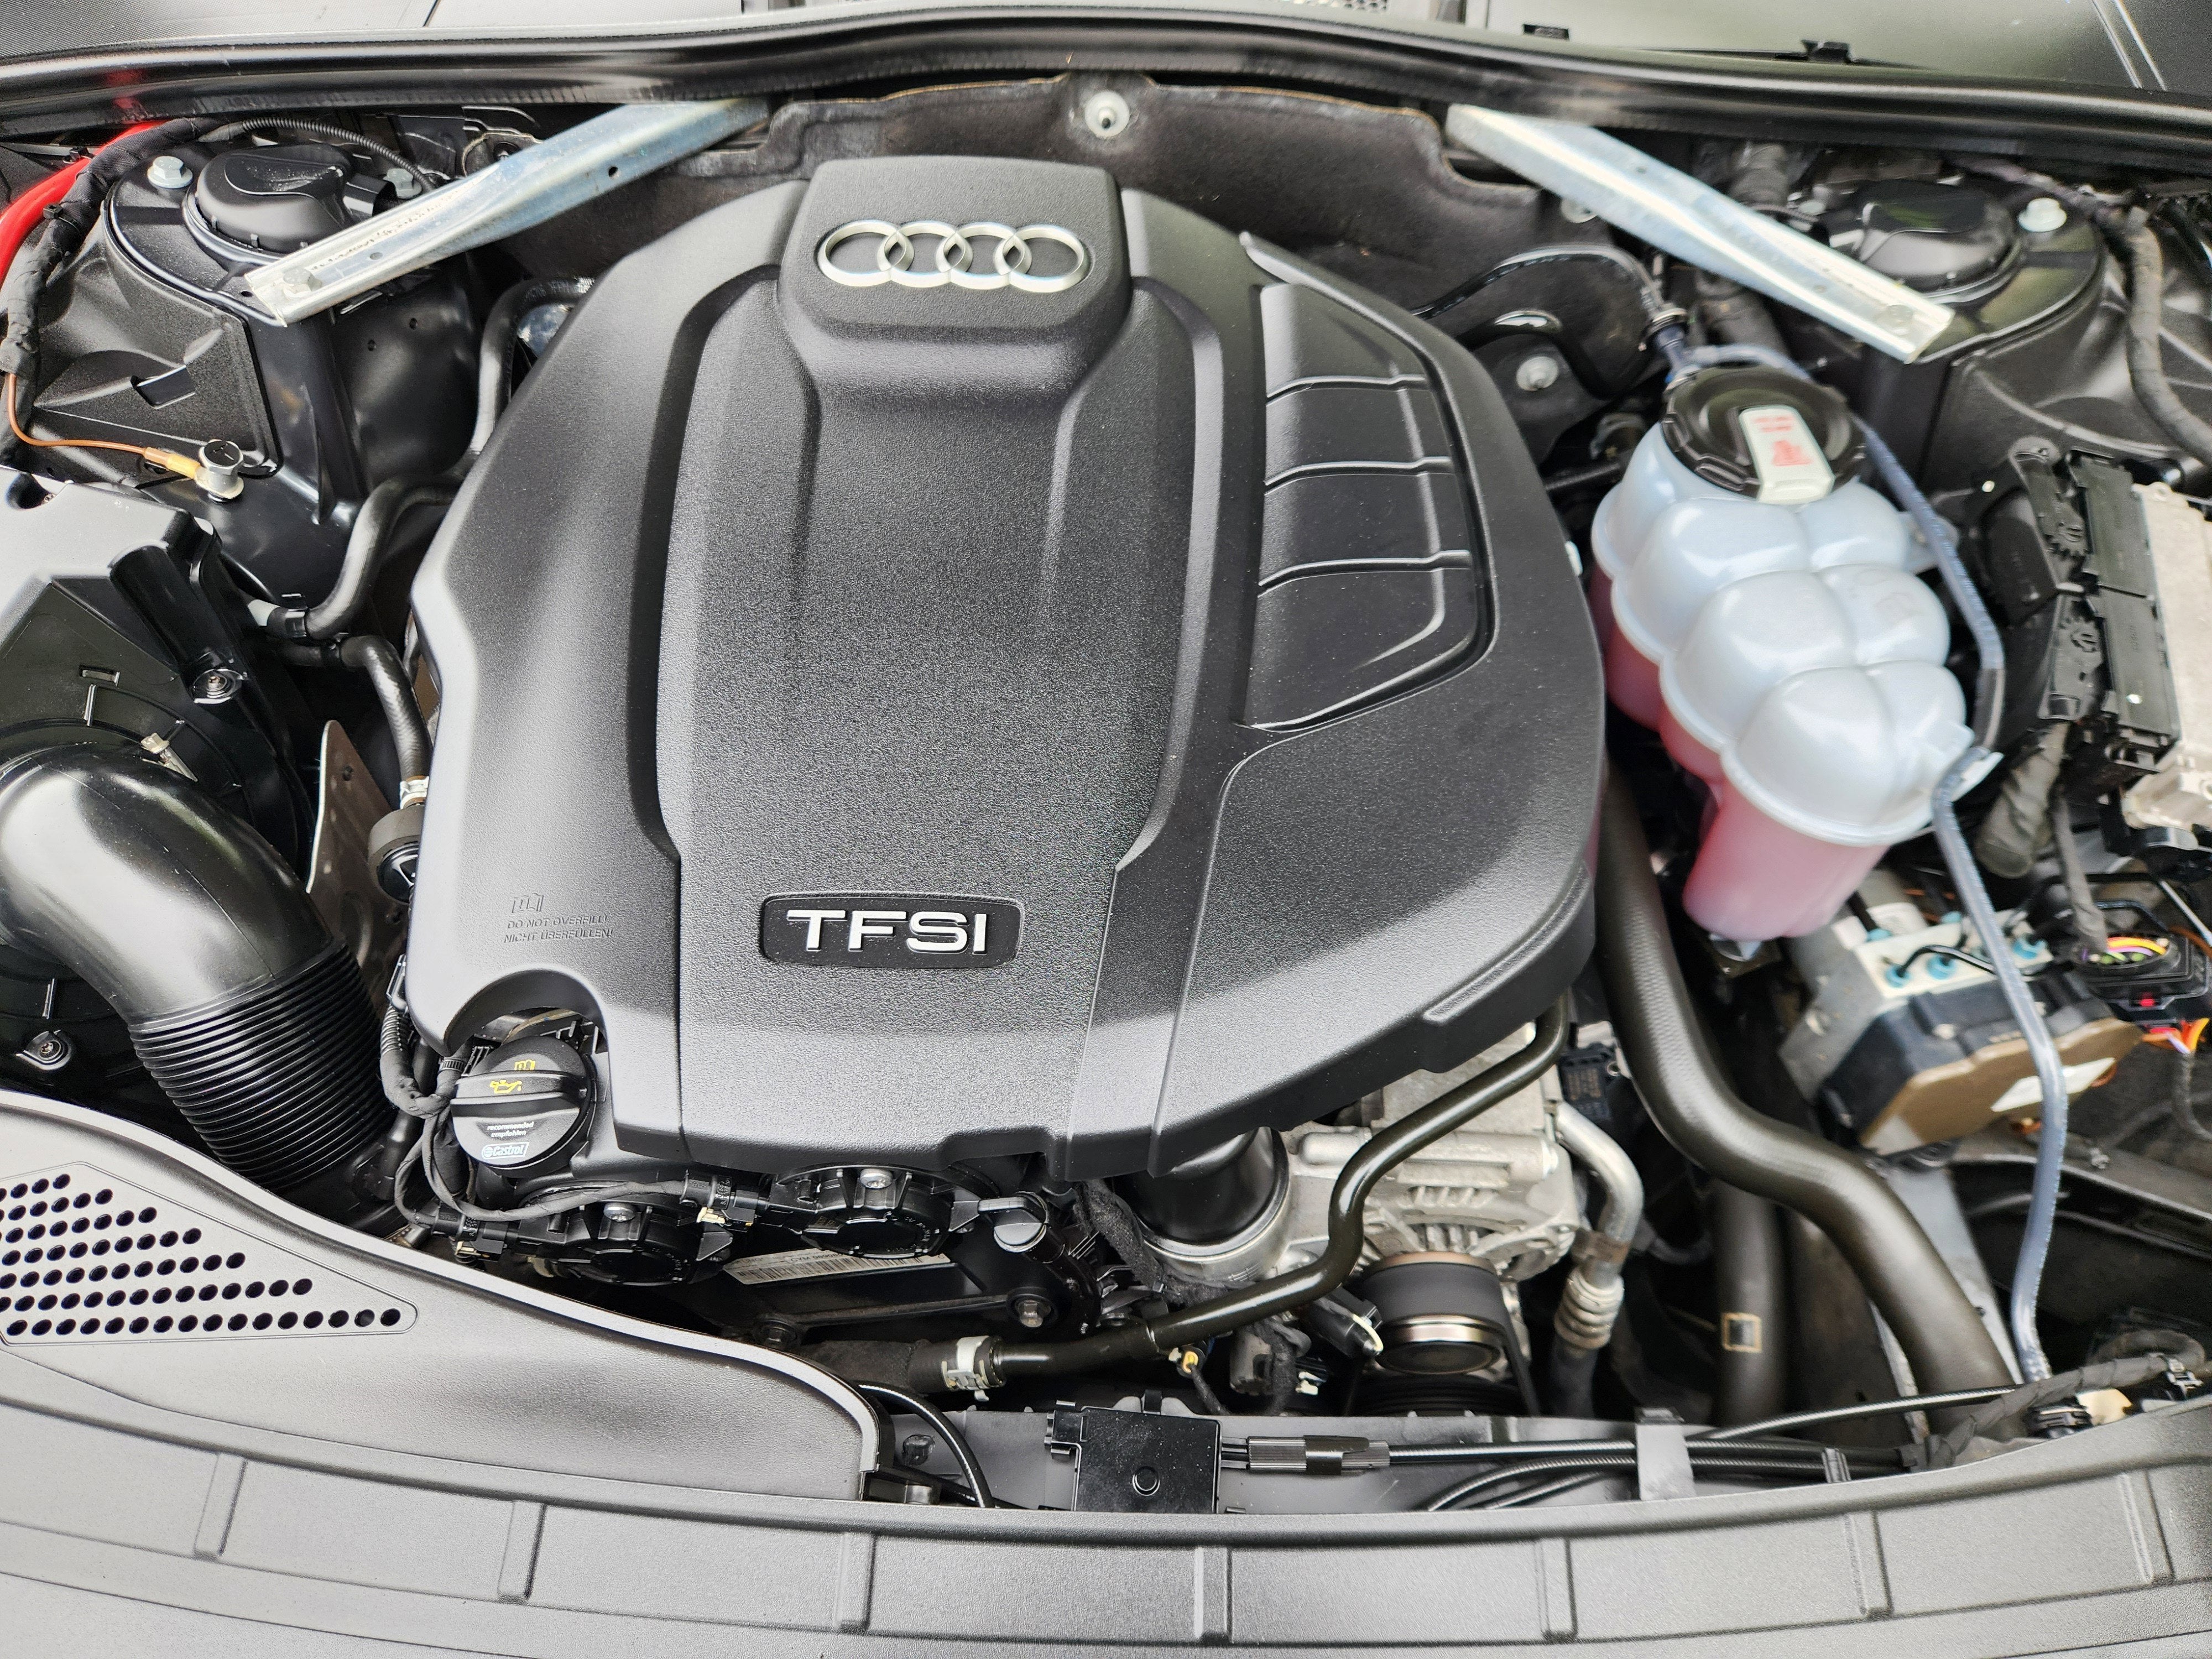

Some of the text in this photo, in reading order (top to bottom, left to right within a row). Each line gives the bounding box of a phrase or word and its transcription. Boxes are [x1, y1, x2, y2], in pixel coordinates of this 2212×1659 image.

[508, 915, 607, 928] DO NOT OVERFILL!
[504, 928, 613, 943] NICHT ÜBERFÜLLEN!
[787, 910, 987, 955] TFSI
[487, 1121, 535, 1131] recommended
[491, 1130, 527, 1138] empfohlen
[493, 1145, 525, 1156] Castrol
